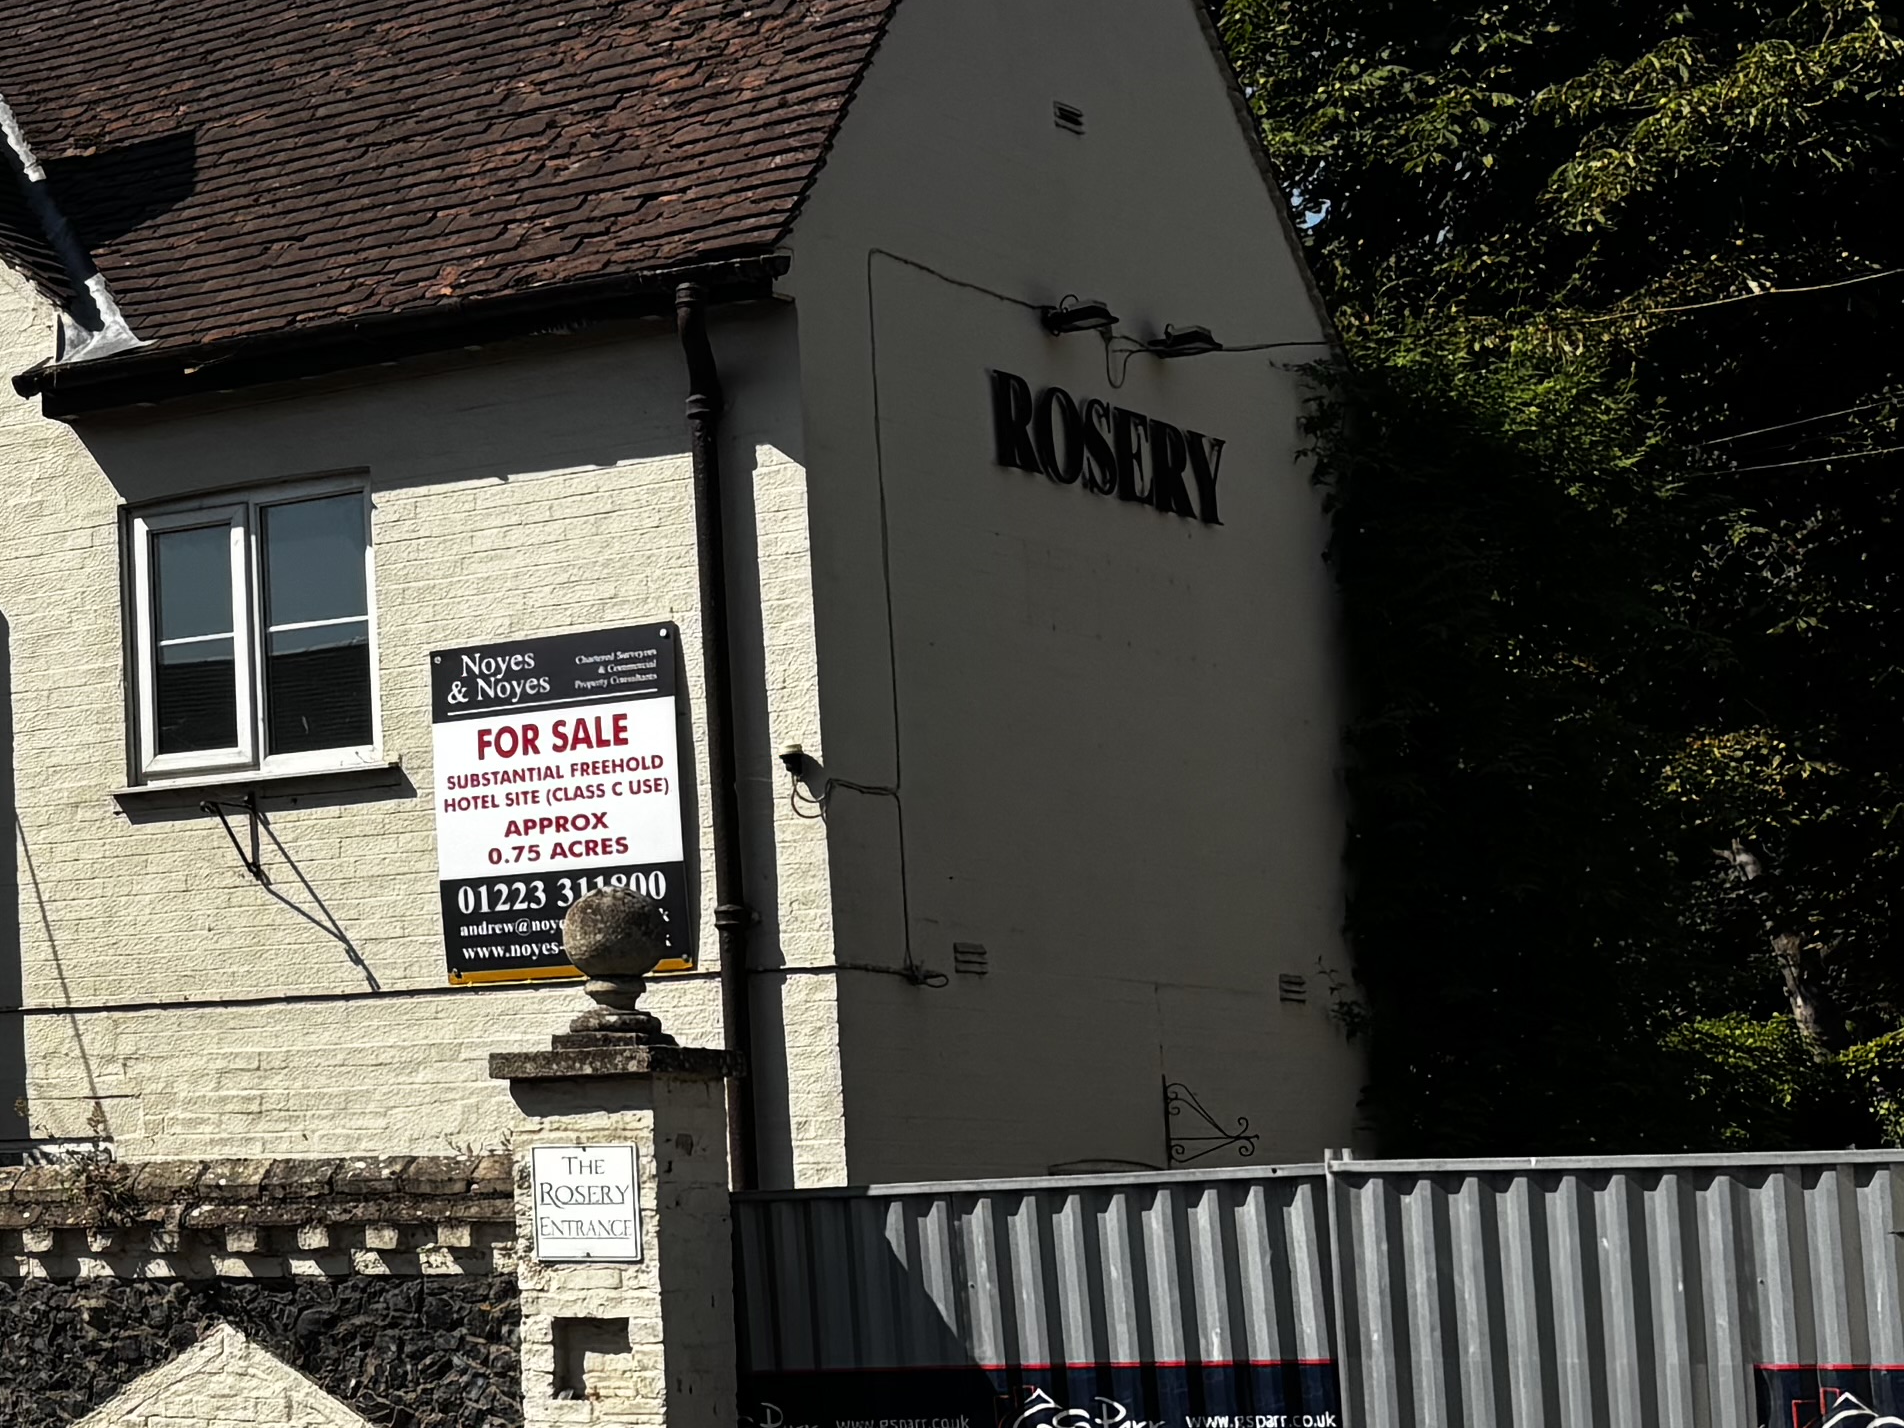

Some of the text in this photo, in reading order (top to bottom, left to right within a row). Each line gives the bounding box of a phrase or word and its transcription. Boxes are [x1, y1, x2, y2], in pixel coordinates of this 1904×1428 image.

[990, 369, 1226, 526] ROSERY
[461, 652, 535, 679] Noyes
[447, 676, 551, 704] & Noyes
[477, 713, 629, 760] FOR SALE
[447, 754, 664, 790] SUBSTANTIAL FREEHOLD
[444, 777, 669, 813] HOTEL SITE (CLASS C USE)
[504, 811, 609, 838] APPROX
[488, 836, 629, 865] 0.75 ACRES
[457, 880, 546, 914] 01223
[561, 1156, 605, 1175] THE
[539, 1182, 630, 1209] ROSERY
[539, 1217, 632, 1237] ENTRANCE
